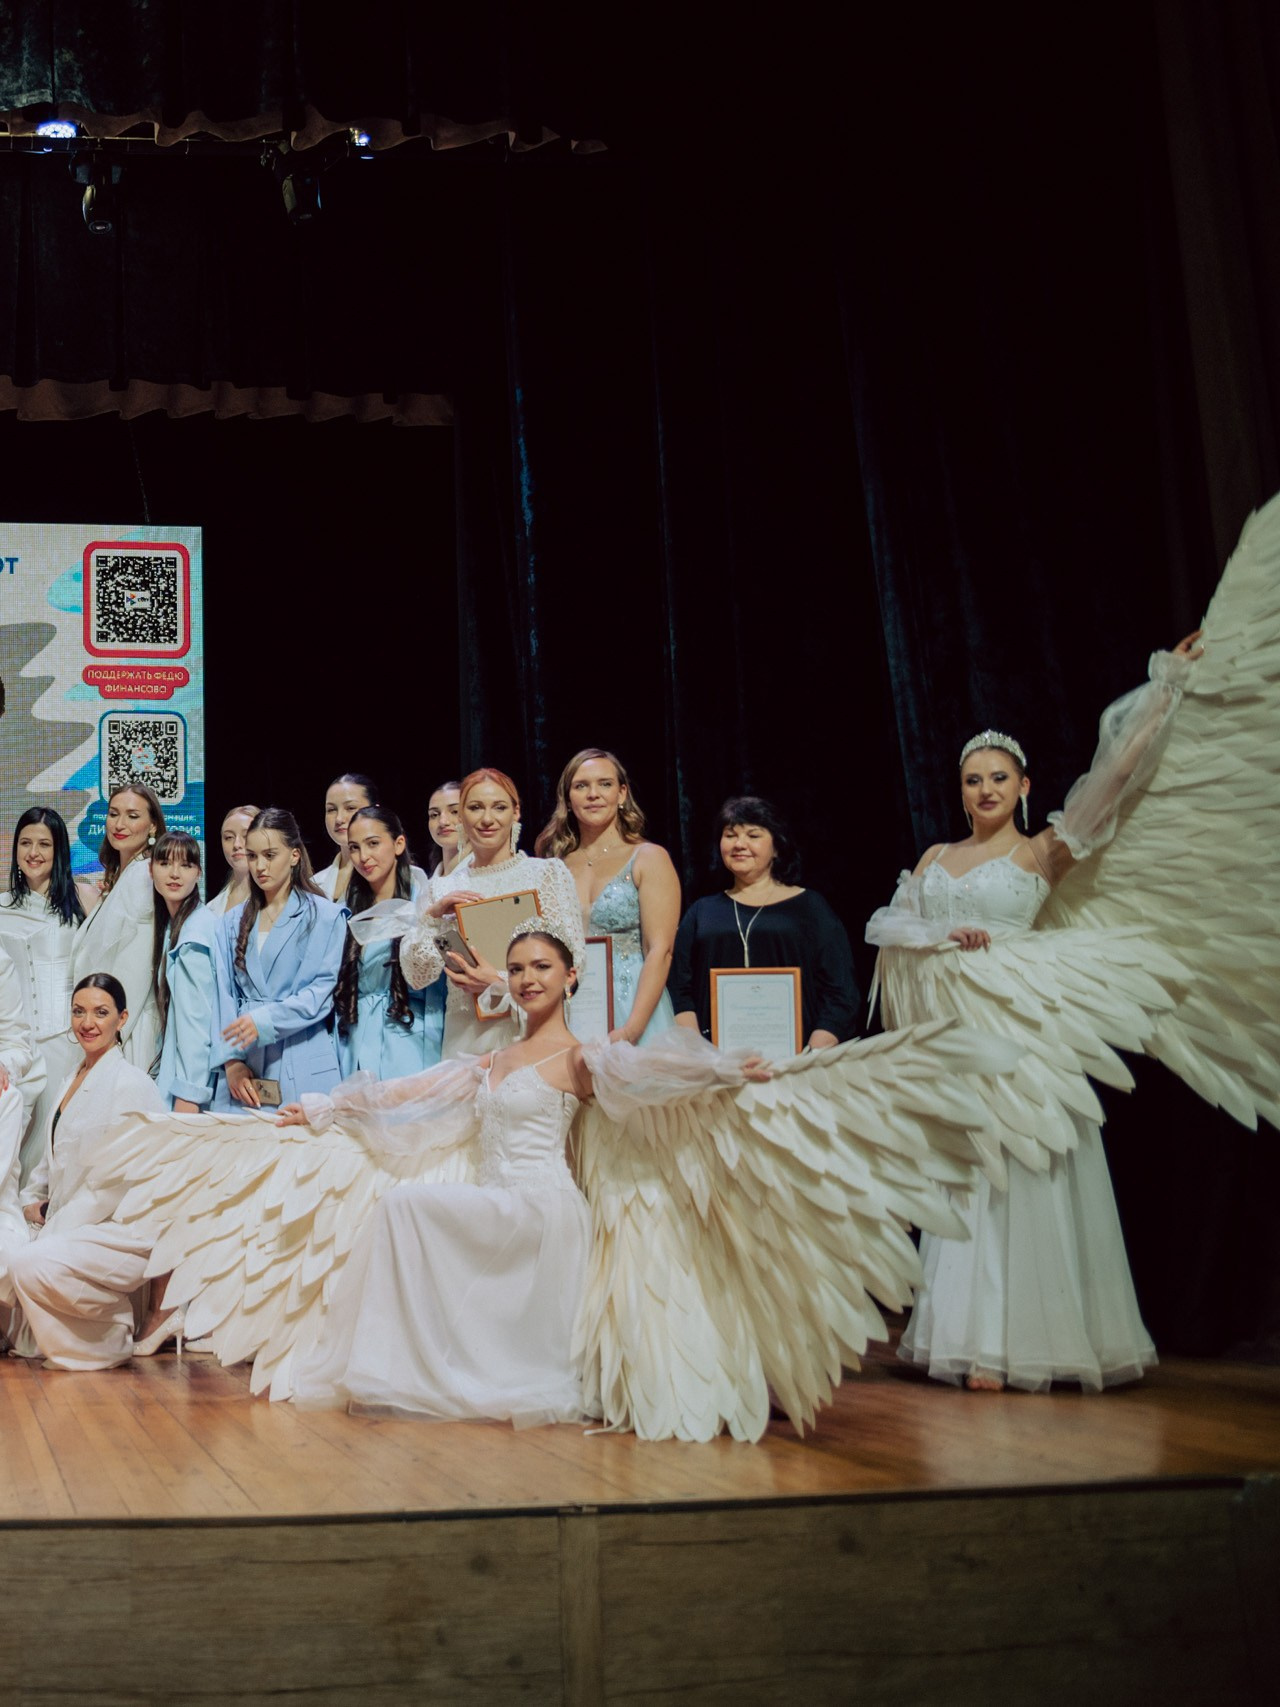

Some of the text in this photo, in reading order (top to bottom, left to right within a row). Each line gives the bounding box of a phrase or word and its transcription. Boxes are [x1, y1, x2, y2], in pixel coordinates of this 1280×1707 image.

[87, 669, 184, 681] ПОДДЕРЖАТЬ ФЕДЮ
[105, 685, 167, 694] ФИНАНСОВО
